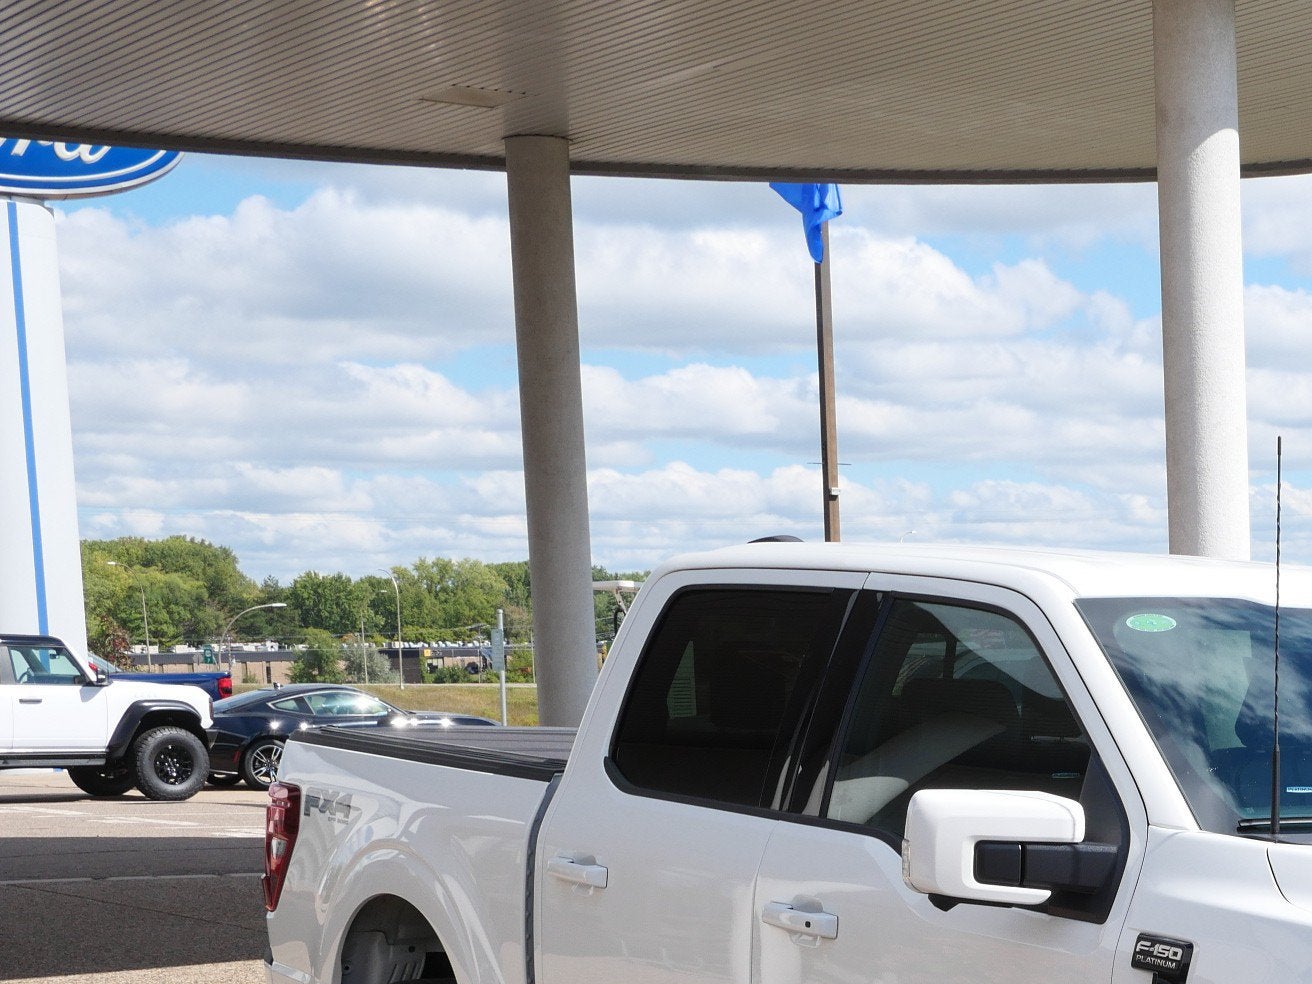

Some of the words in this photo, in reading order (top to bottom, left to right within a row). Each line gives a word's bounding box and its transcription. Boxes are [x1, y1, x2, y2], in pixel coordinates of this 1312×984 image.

[304, 787, 353, 819] FX4
[1135, 940, 1183, 961] F-150
[1135, 954, 1176, 969] PLATINUM
